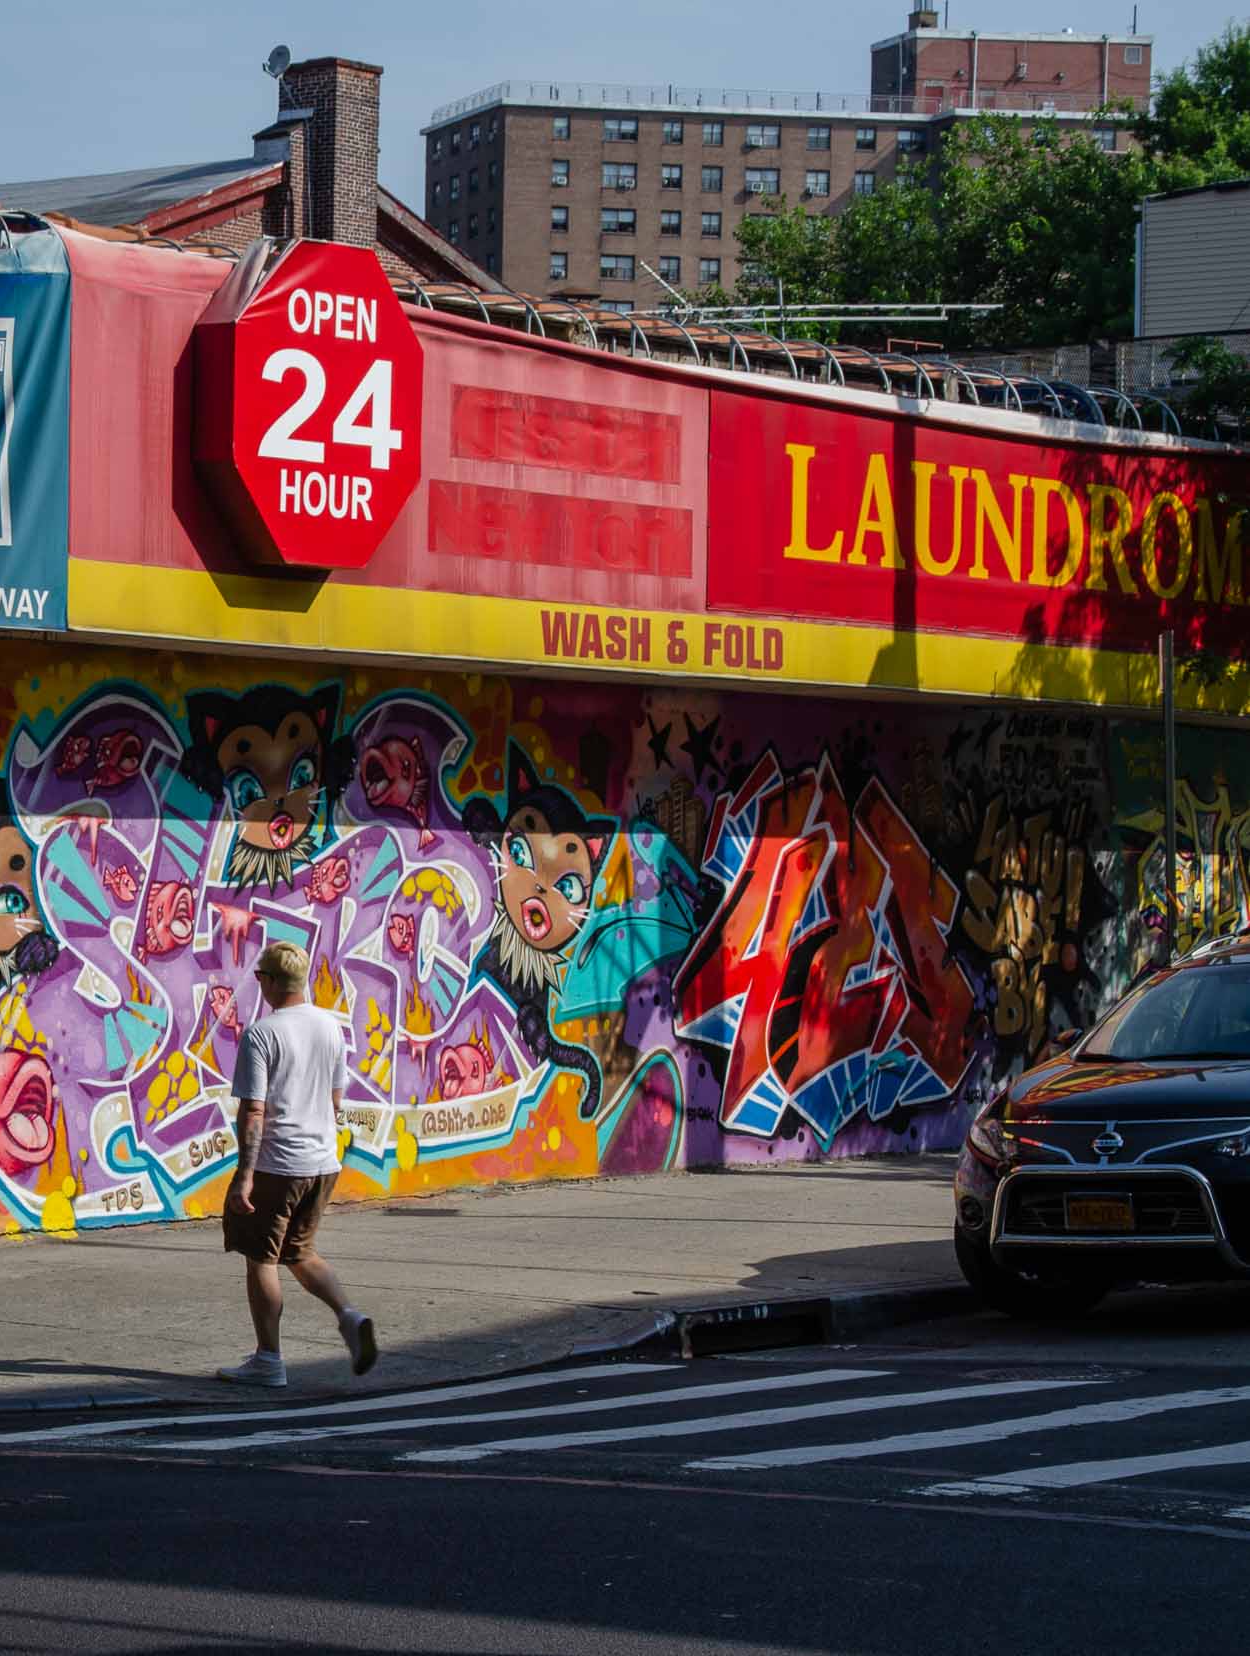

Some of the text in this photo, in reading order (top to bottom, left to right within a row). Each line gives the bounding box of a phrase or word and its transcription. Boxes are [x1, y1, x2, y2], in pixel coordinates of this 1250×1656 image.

[287, 287, 378, 343] OPEN
[257, 347, 403, 470] 24
[279, 468, 374, 521] HOUR
[783, 441, 1249, 606] LAUNDROM
[540, 610, 784, 671] WASH & FOLD
[101, 1182, 144, 1213] TDS
